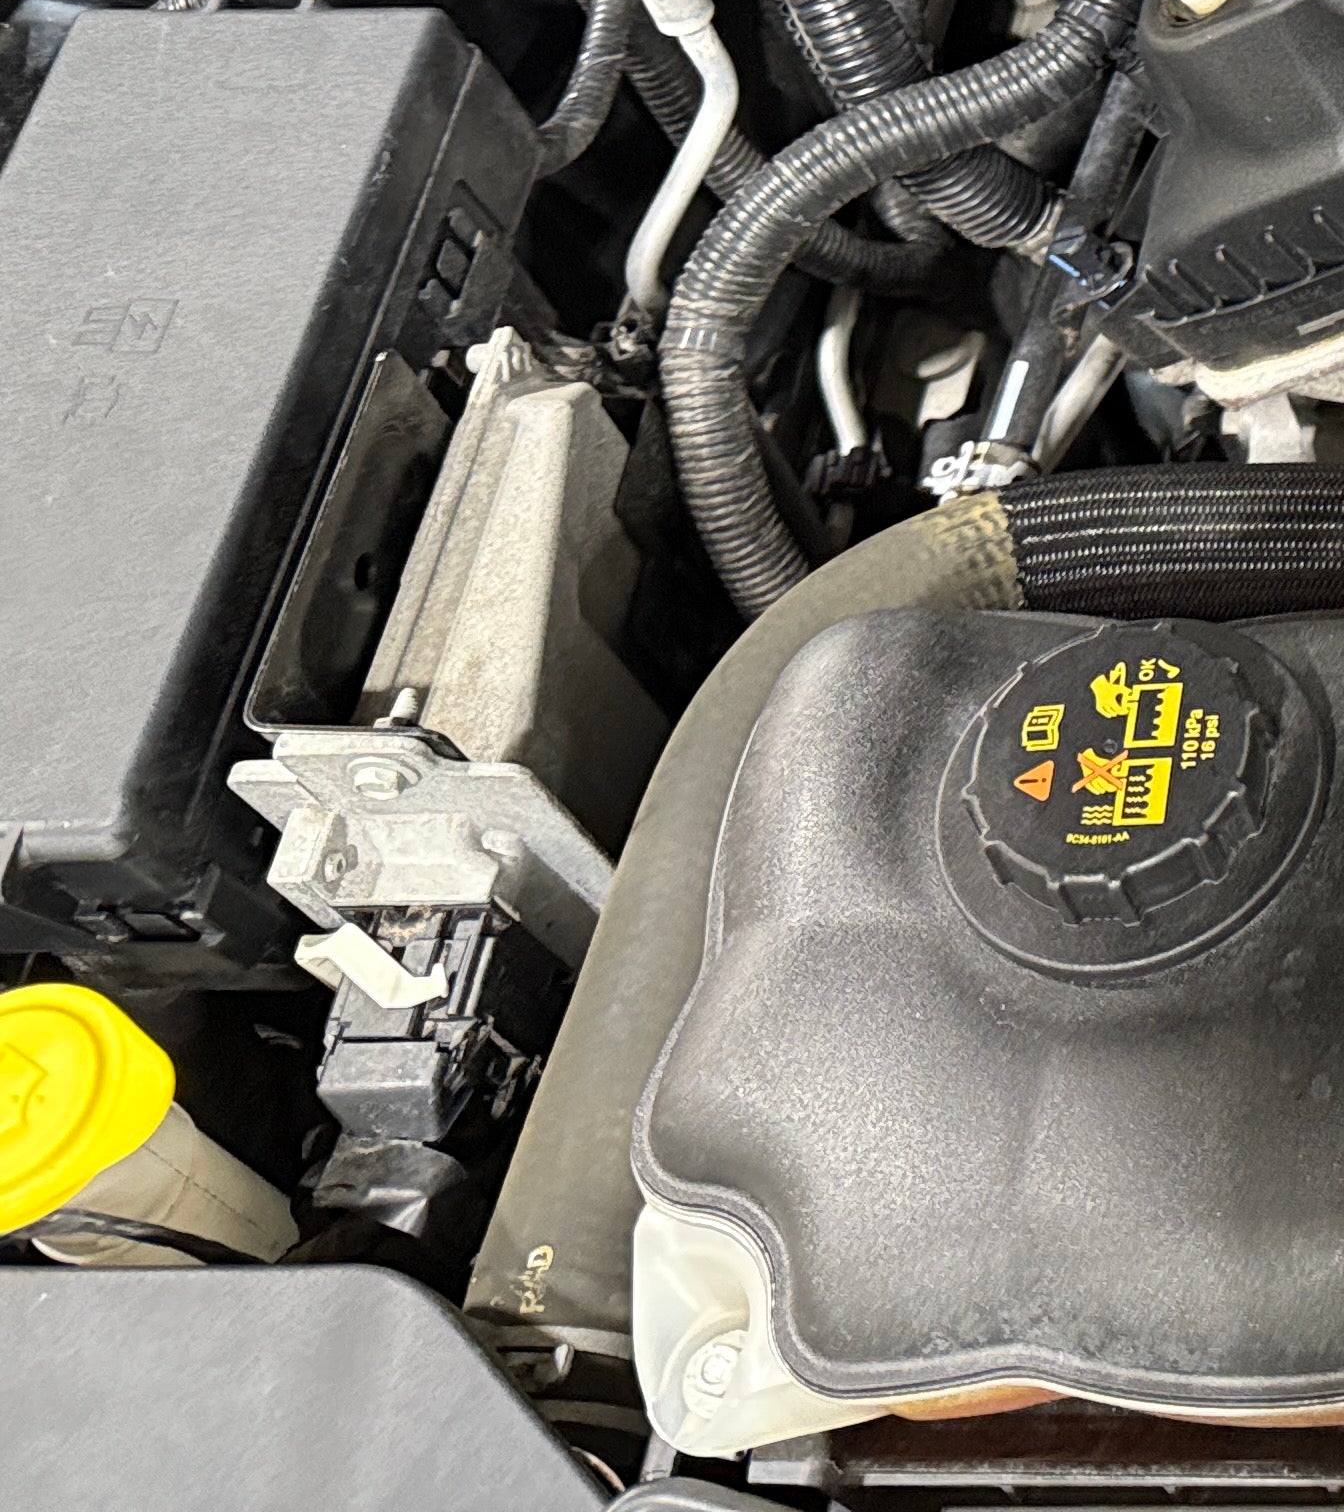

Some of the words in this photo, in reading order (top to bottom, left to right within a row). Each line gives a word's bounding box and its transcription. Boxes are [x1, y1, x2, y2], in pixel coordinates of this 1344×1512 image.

[1139, 657, 1157, 679] OK
[1183, 708, 1203, 738] kPa
[1204, 714, 1220, 738] psi
[1180, 740, 1199, 770] 110
[1200, 740, 1216, 761] 16
